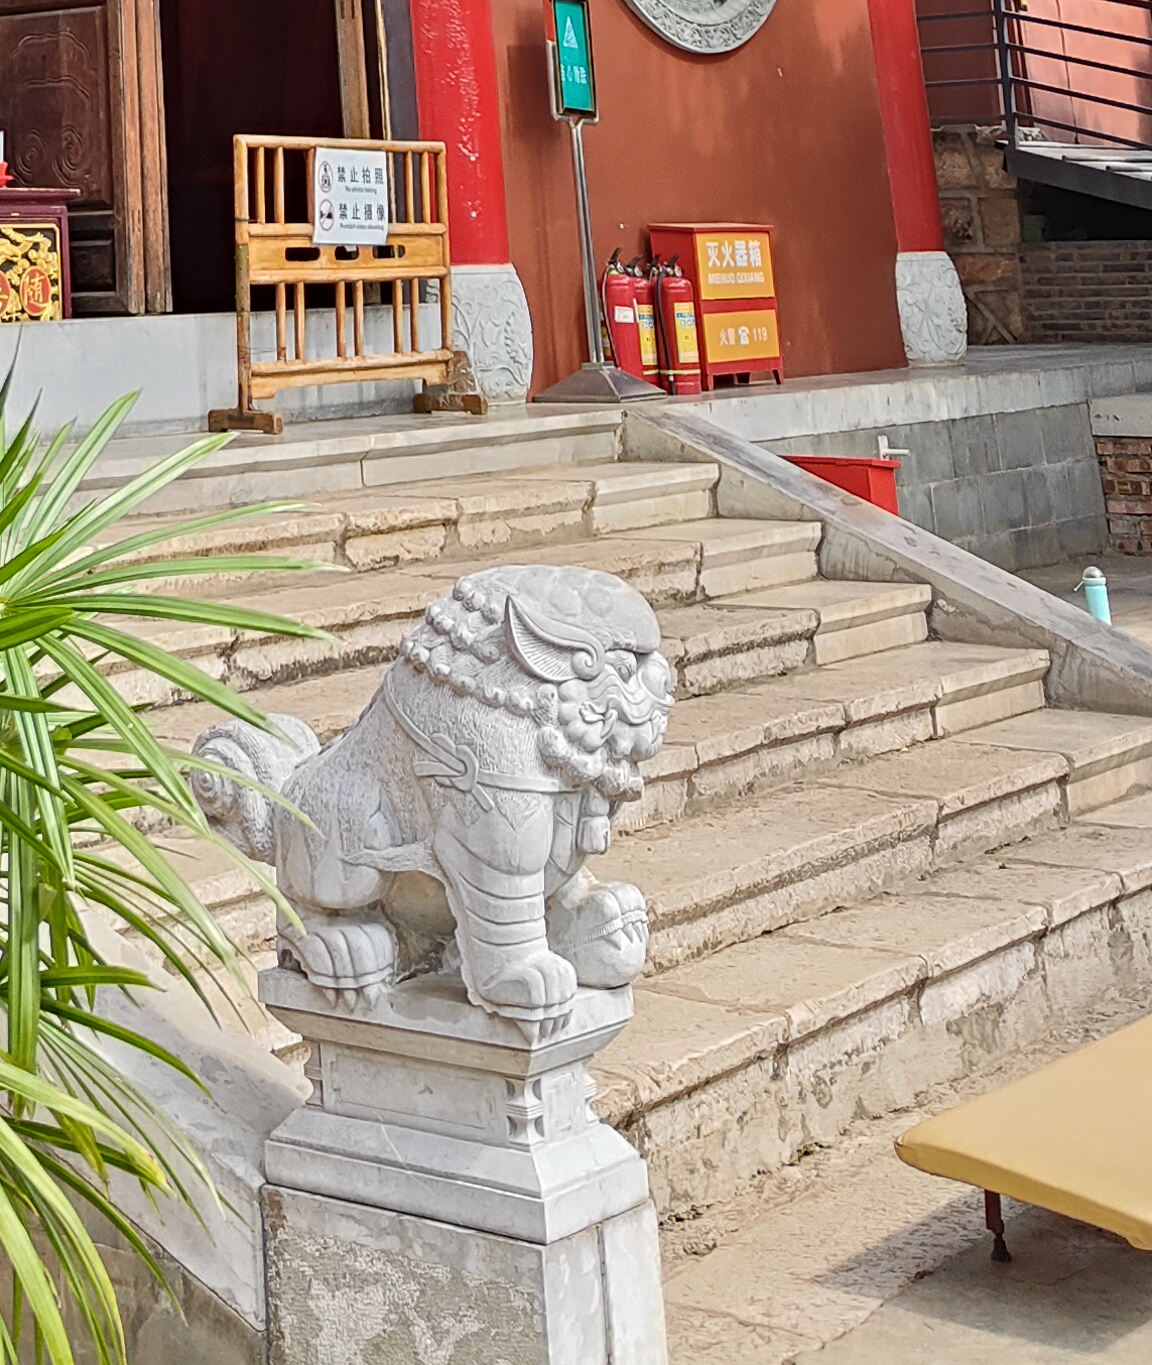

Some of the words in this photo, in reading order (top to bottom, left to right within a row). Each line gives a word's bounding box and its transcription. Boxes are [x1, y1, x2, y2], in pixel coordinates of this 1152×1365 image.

[337, 166, 384, 185] 禁止拍照
[338, 203, 385, 222] 禁止摄像
[706, 239, 762, 268] 灭火器箱
[752, 326, 768, 341] 119
